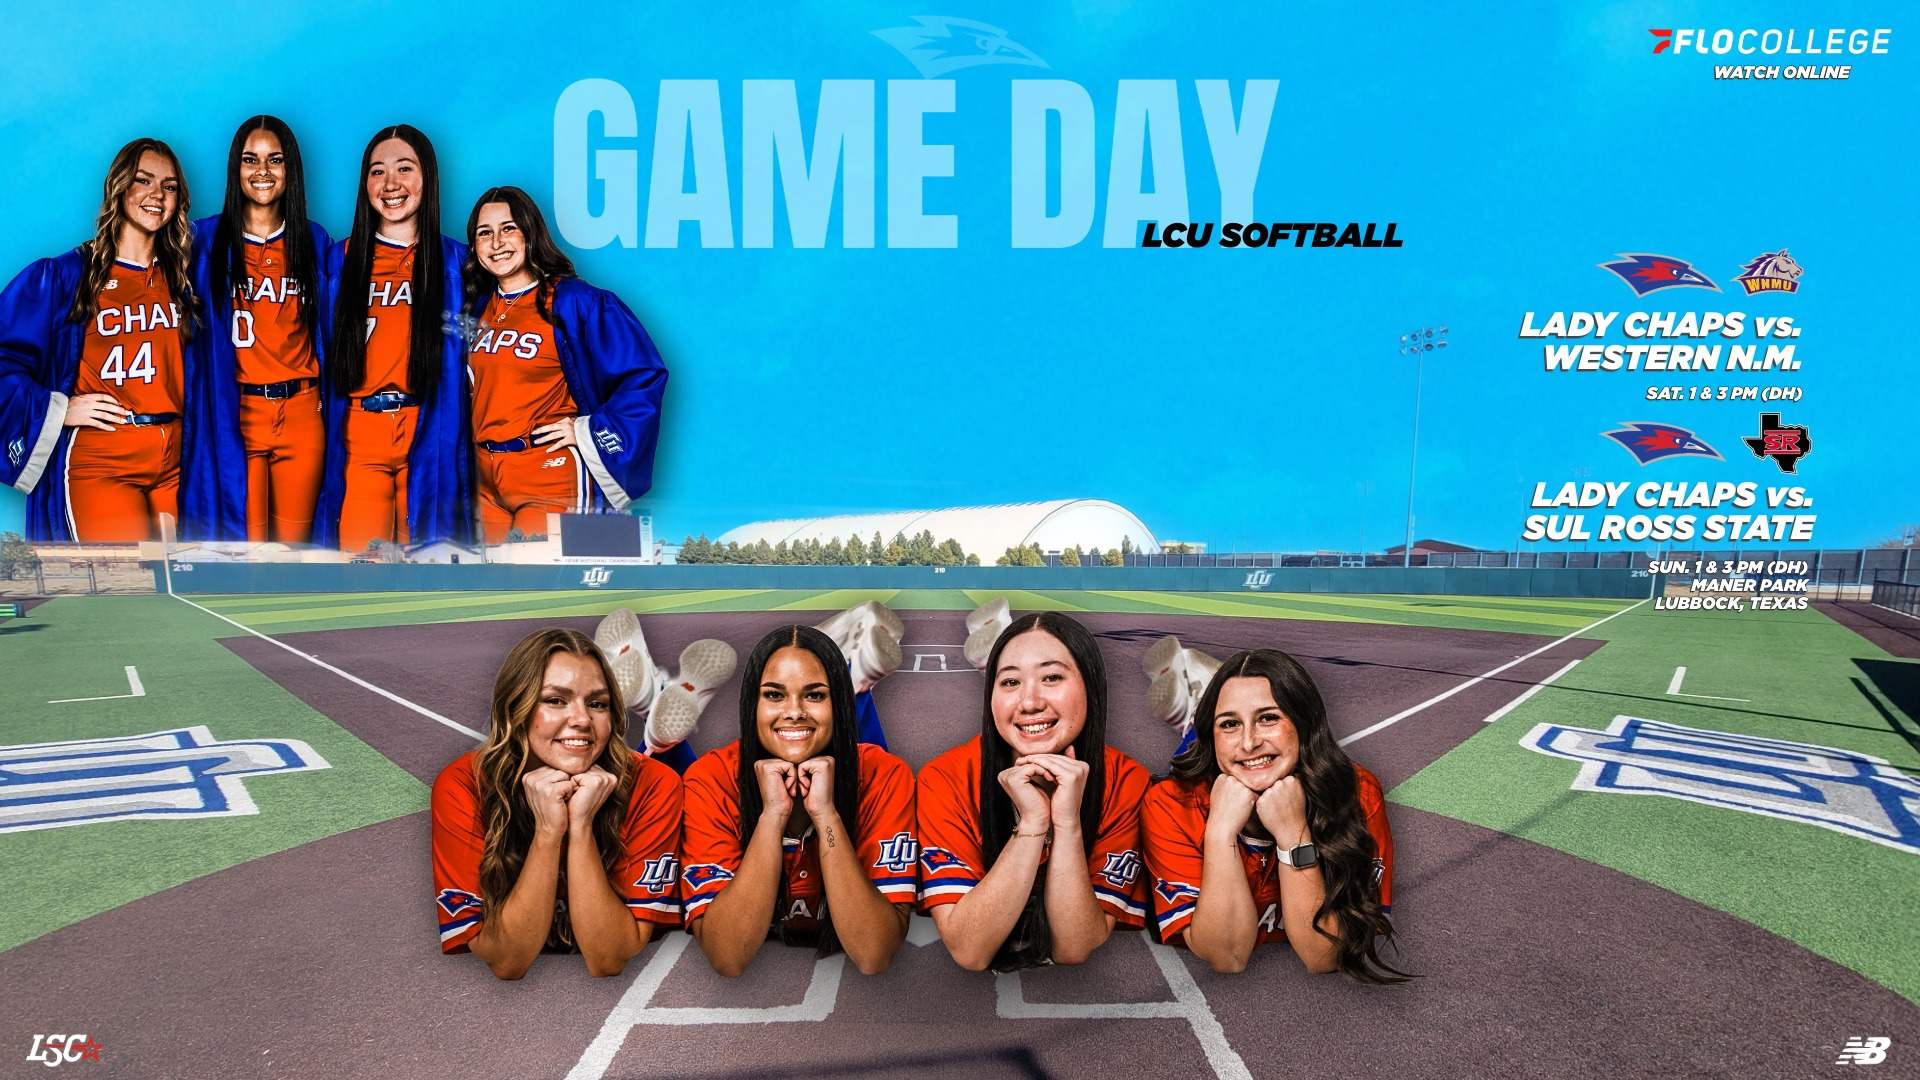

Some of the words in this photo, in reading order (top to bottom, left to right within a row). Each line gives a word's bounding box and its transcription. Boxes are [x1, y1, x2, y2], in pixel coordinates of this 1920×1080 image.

[97, 302, 182, 337] CHA
[100, 341, 156, 386] 44
[172, 563, 194, 573] 210
